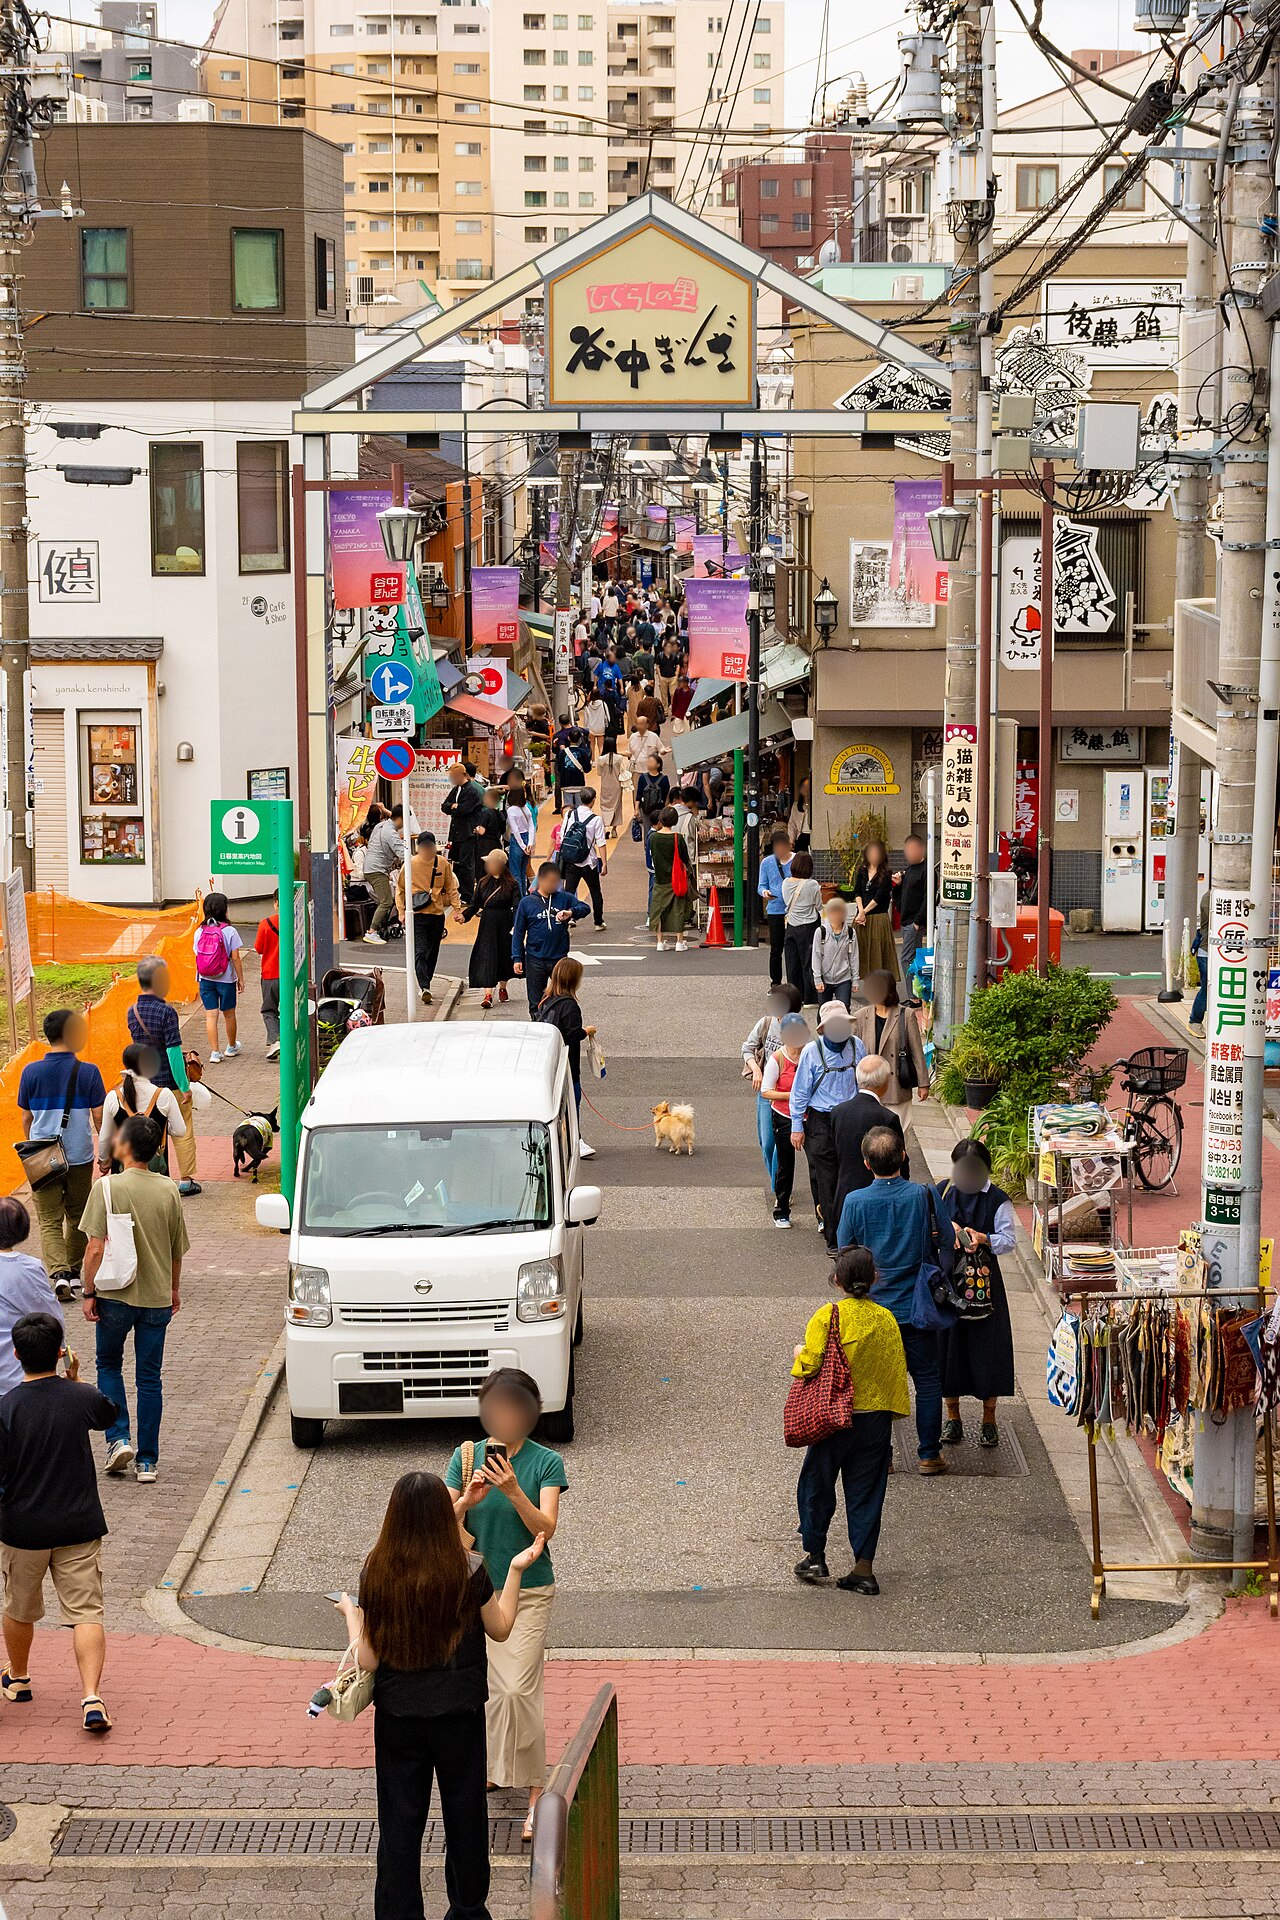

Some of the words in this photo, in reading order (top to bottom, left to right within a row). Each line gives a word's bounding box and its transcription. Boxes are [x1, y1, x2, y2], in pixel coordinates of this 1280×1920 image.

[589, 278, 698, 311] ひぐらしの里
[566, 305, 736, 389] 谷中ぎんざ
[334, 542, 368, 550] SHOPPING
[374, 577, 398, 587] 谷中
[374, 588, 398, 599] ぎんざ
[270, 602, 286, 612] Café
[271, 614, 287, 624] Shop
[724, 656, 743, 665] 谷中
[1006, 648, 1042, 660] ひみつ
[55, 685, 86, 696] yanaka
[87, 683, 131, 693] kenshindo
[375, 709, 411, 719] 自転車を除く
[375, 719, 411, 727] 一方通行
[833, 752, 849, 775] GENUINE
[871, 748, 891, 775] PRODUCTS
[945, 758, 955, 796] のお店
[956, 748, 973, 803] 猫雑貨
[345, 745, 376, 826] 生ビー
[945, 882, 968, 890] 西日暮里
[1216, 966, 1247, 1036] 田戸
[1211, 1042, 1244, 1062] 新客歓
[1210, 1064, 1243, 1083] 貴金属買
[1209, 1109, 1233, 1120] Facebook
[1208, 1137, 1242, 1151] ここから3
[1207, 1151, 1242, 1164] 谷中3-21
[1210, 1205, 1240, 1218] 3-13
